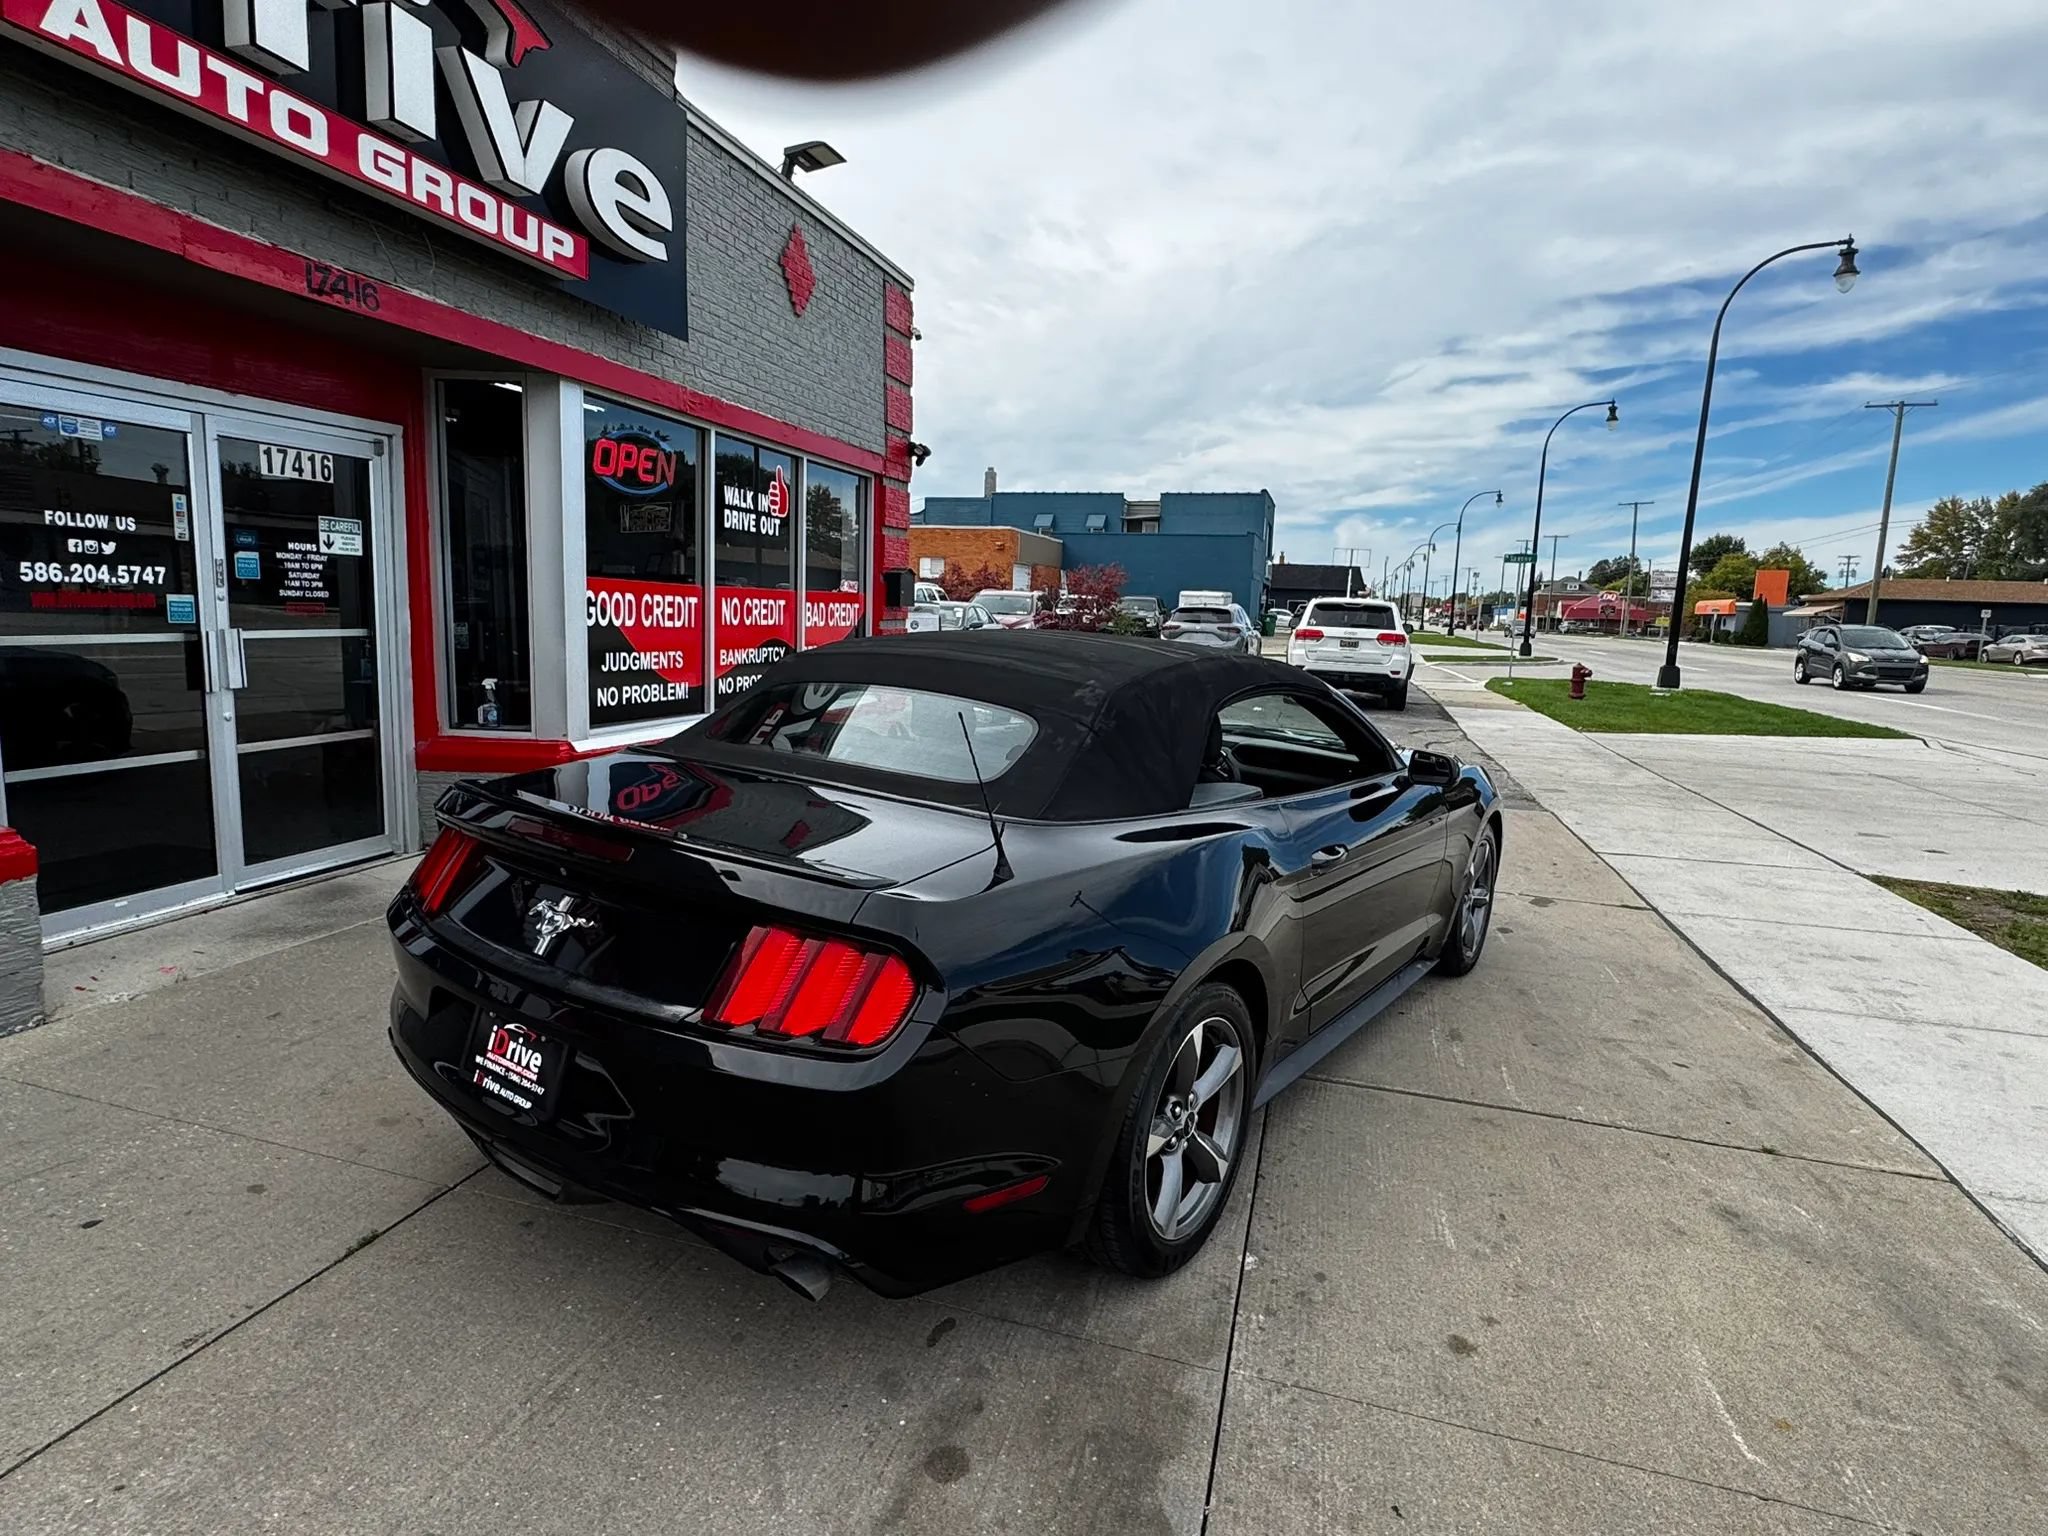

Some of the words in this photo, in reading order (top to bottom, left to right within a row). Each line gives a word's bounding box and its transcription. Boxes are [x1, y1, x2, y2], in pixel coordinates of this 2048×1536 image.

[39, 0, 329, 157] AUTO
[357, 133, 574, 262] GROUP
[306, 261, 380, 311] 17416
[263, 447, 331, 482] 17416
[593, 438, 676, 486] OPEN
[723, 484, 754, 510] WALK
[758, 493, 769, 513] IN
[44, 510, 109, 529] FOLLOW
[115, 516, 137, 532] US
[320, 520, 330, 531] BE
[330, 521, 360, 534] CAREFUL
[723, 511, 756, 534] DRIVE
[760, 518, 781, 537] OUT
[276, 552, 302, 560] MONDAY
[307, 554, 328, 562] FRIDAY
[288, 542, 317, 551] HOURS
[19, 562, 166, 585] 586.204.5747
[288, 571, 320, 579] SATURDAY
[279, 589, 303, 597] SUNDAY
[305, 590, 329, 598] CLOSED
[586, 590, 637, 628] GOOD
[641, 596, 698, 628] CREDIT
[721, 598, 741, 626] NO
[743, 599, 786, 626] CREDIT
[806, 602, 826, 627] BAD
[828, 602, 860, 627] CREDIT
[601, 651, 684, 672] JUDGMENTS
[720, 646, 786, 666] BANKRUPTCY
[596, 686, 620, 707] NO
[622, 682, 689, 705] PROBLEM!
[718, 677, 734, 694] NO
[487, 1024, 542, 1073] iDrive
[475, 1054, 484, 1065] WE
[484, 1059, 506, 1076] FINANCE
[500, 1087, 514, 1101] AUTO
[513, 1095, 532, 1109] GROUP
